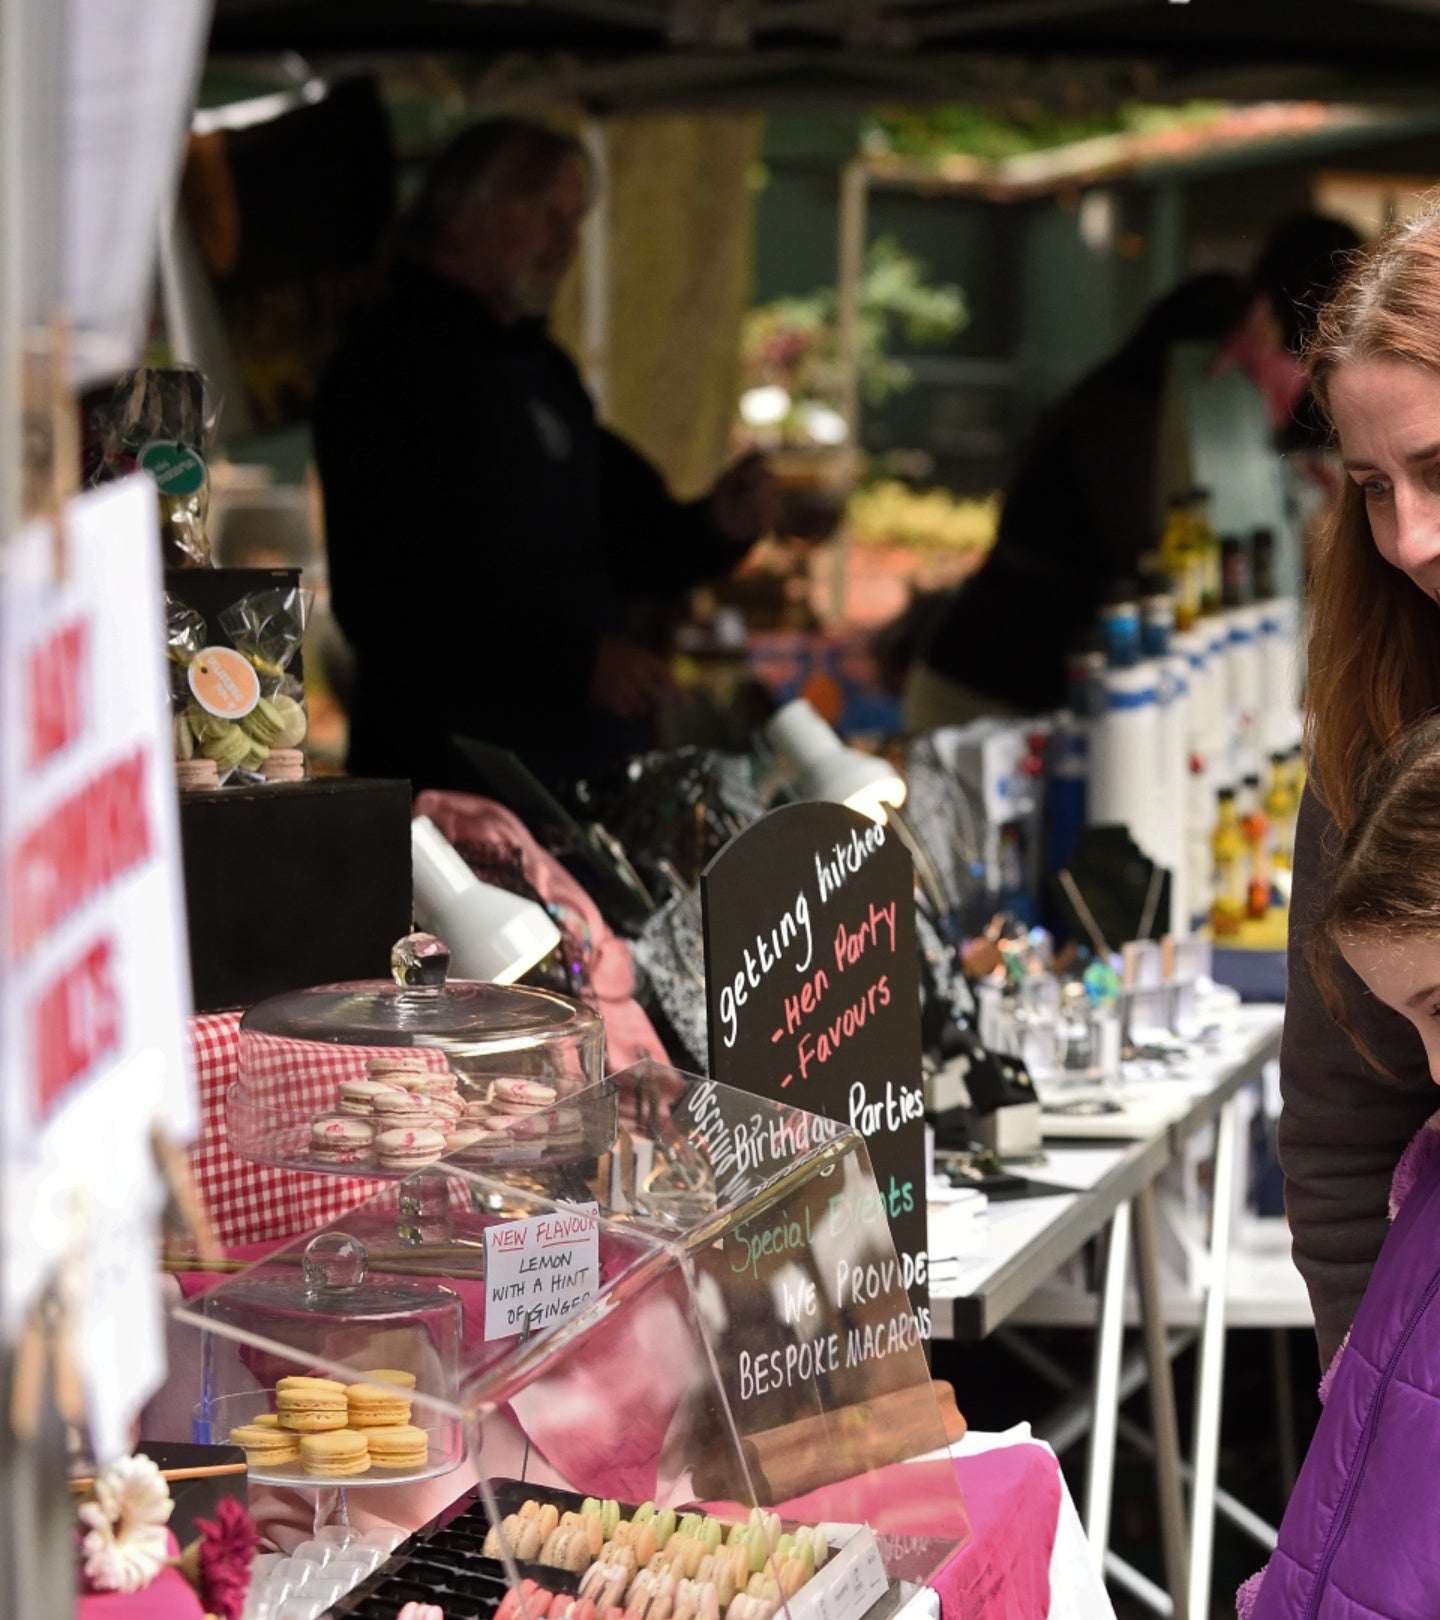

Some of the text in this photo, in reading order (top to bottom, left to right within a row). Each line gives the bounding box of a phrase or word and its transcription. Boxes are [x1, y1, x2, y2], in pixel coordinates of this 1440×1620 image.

[834, 901, 896, 972] Party
[720, 889, 812, 1048] getting
[849, 1081, 924, 1137] Parties
[491, 1226, 528, 1248] NEW
[519, 1250, 573, 1274] LEMON
[731, 1205, 817, 1279] Special
[492, 1266, 590, 1303] WITH A HINT
[507, 1304, 524, 1325] OF
[783, 1250, 929, 1324] WE PROVIDE
[740, 1334, 840, 1400] BESPOKE
